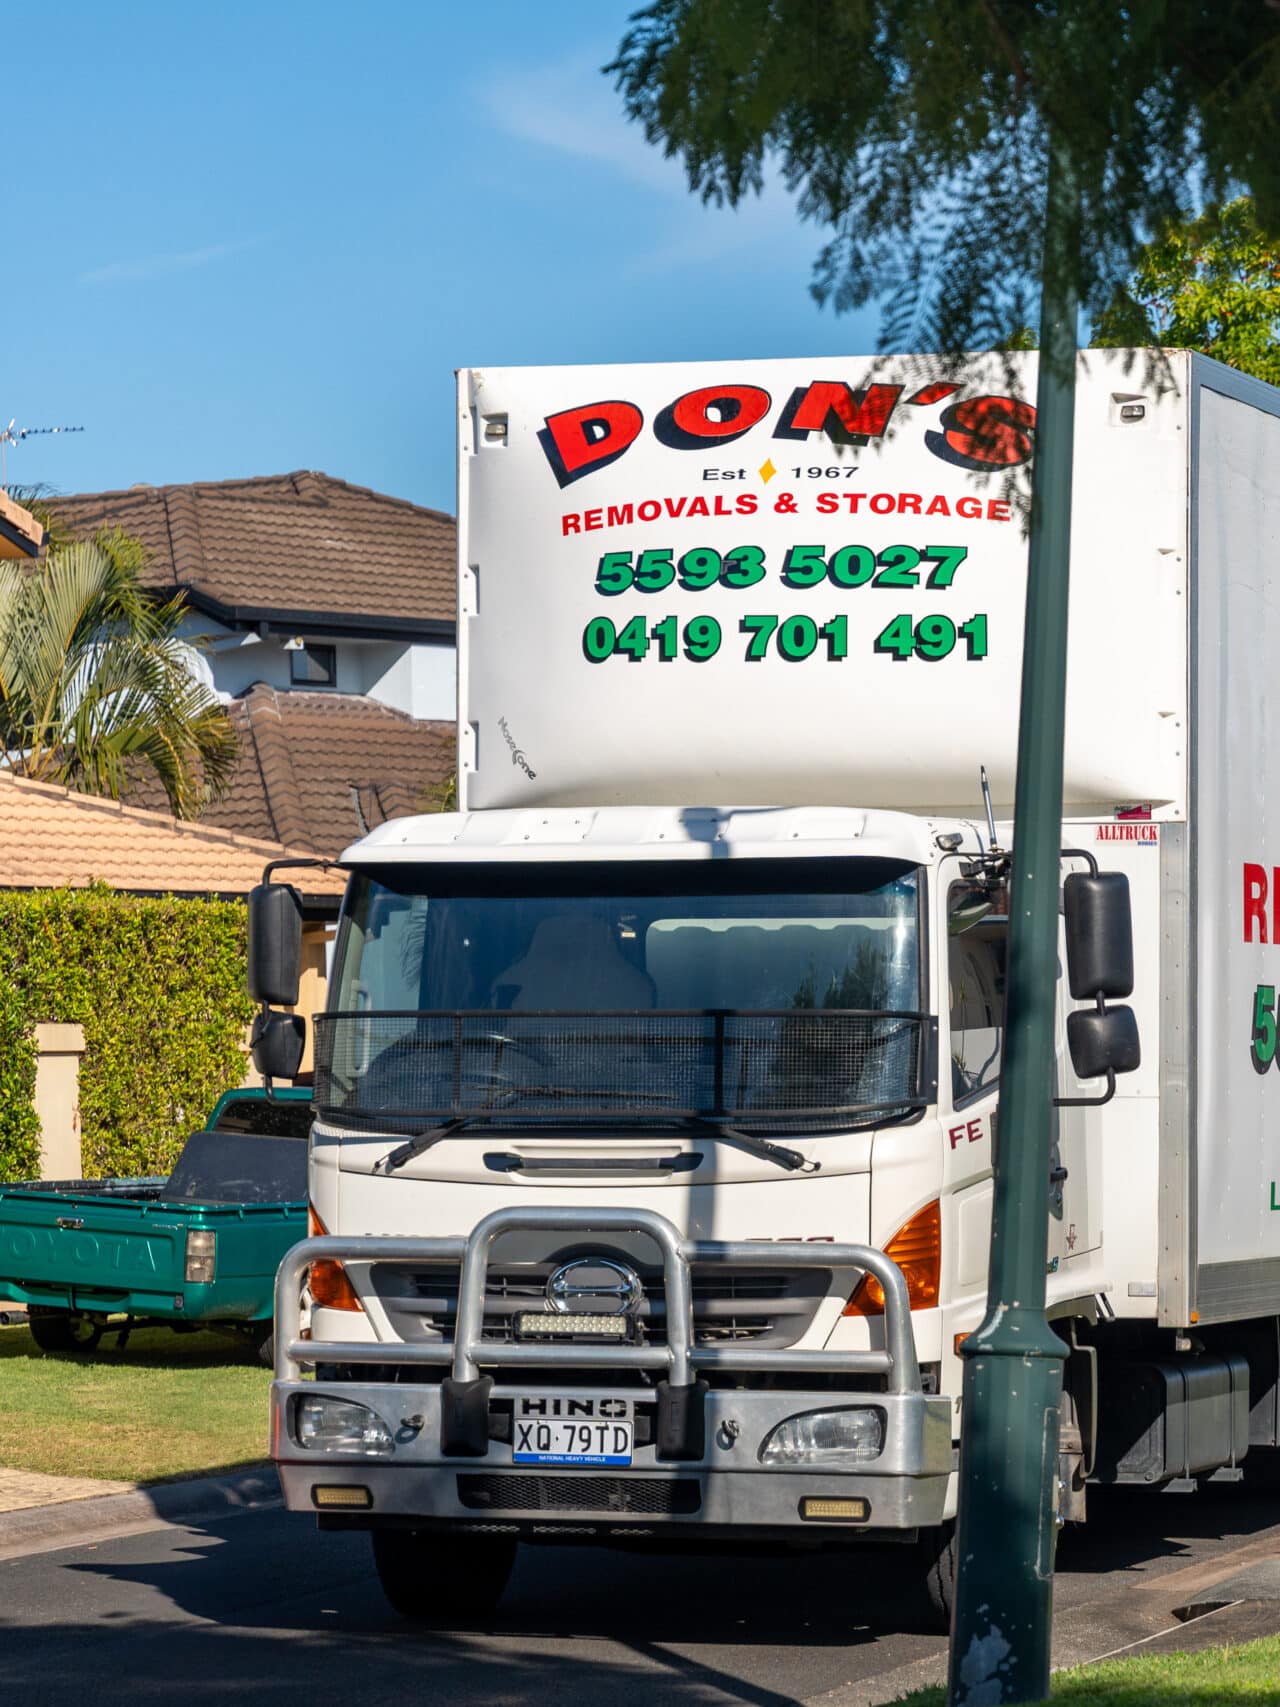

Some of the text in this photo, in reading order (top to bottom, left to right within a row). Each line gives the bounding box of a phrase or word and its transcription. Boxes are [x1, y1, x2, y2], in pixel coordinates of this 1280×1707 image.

[536, 380, 1037, 489] DON'S
[702, 467, 859, 481] Est 1967
[561, 492, 1012, 537] REMOVALS & STORAGE
[595, 545, 968, 596] 5593 5027
[583, 613, 988, 663] 0419 701 491
[1097, 825, 1158, 840] ALLTRUCK
[949, 1118, 983, 1150] FE
[0, 1228, 156, 1272] OYOTA
[521, 1398, 627, 1418] HINO
